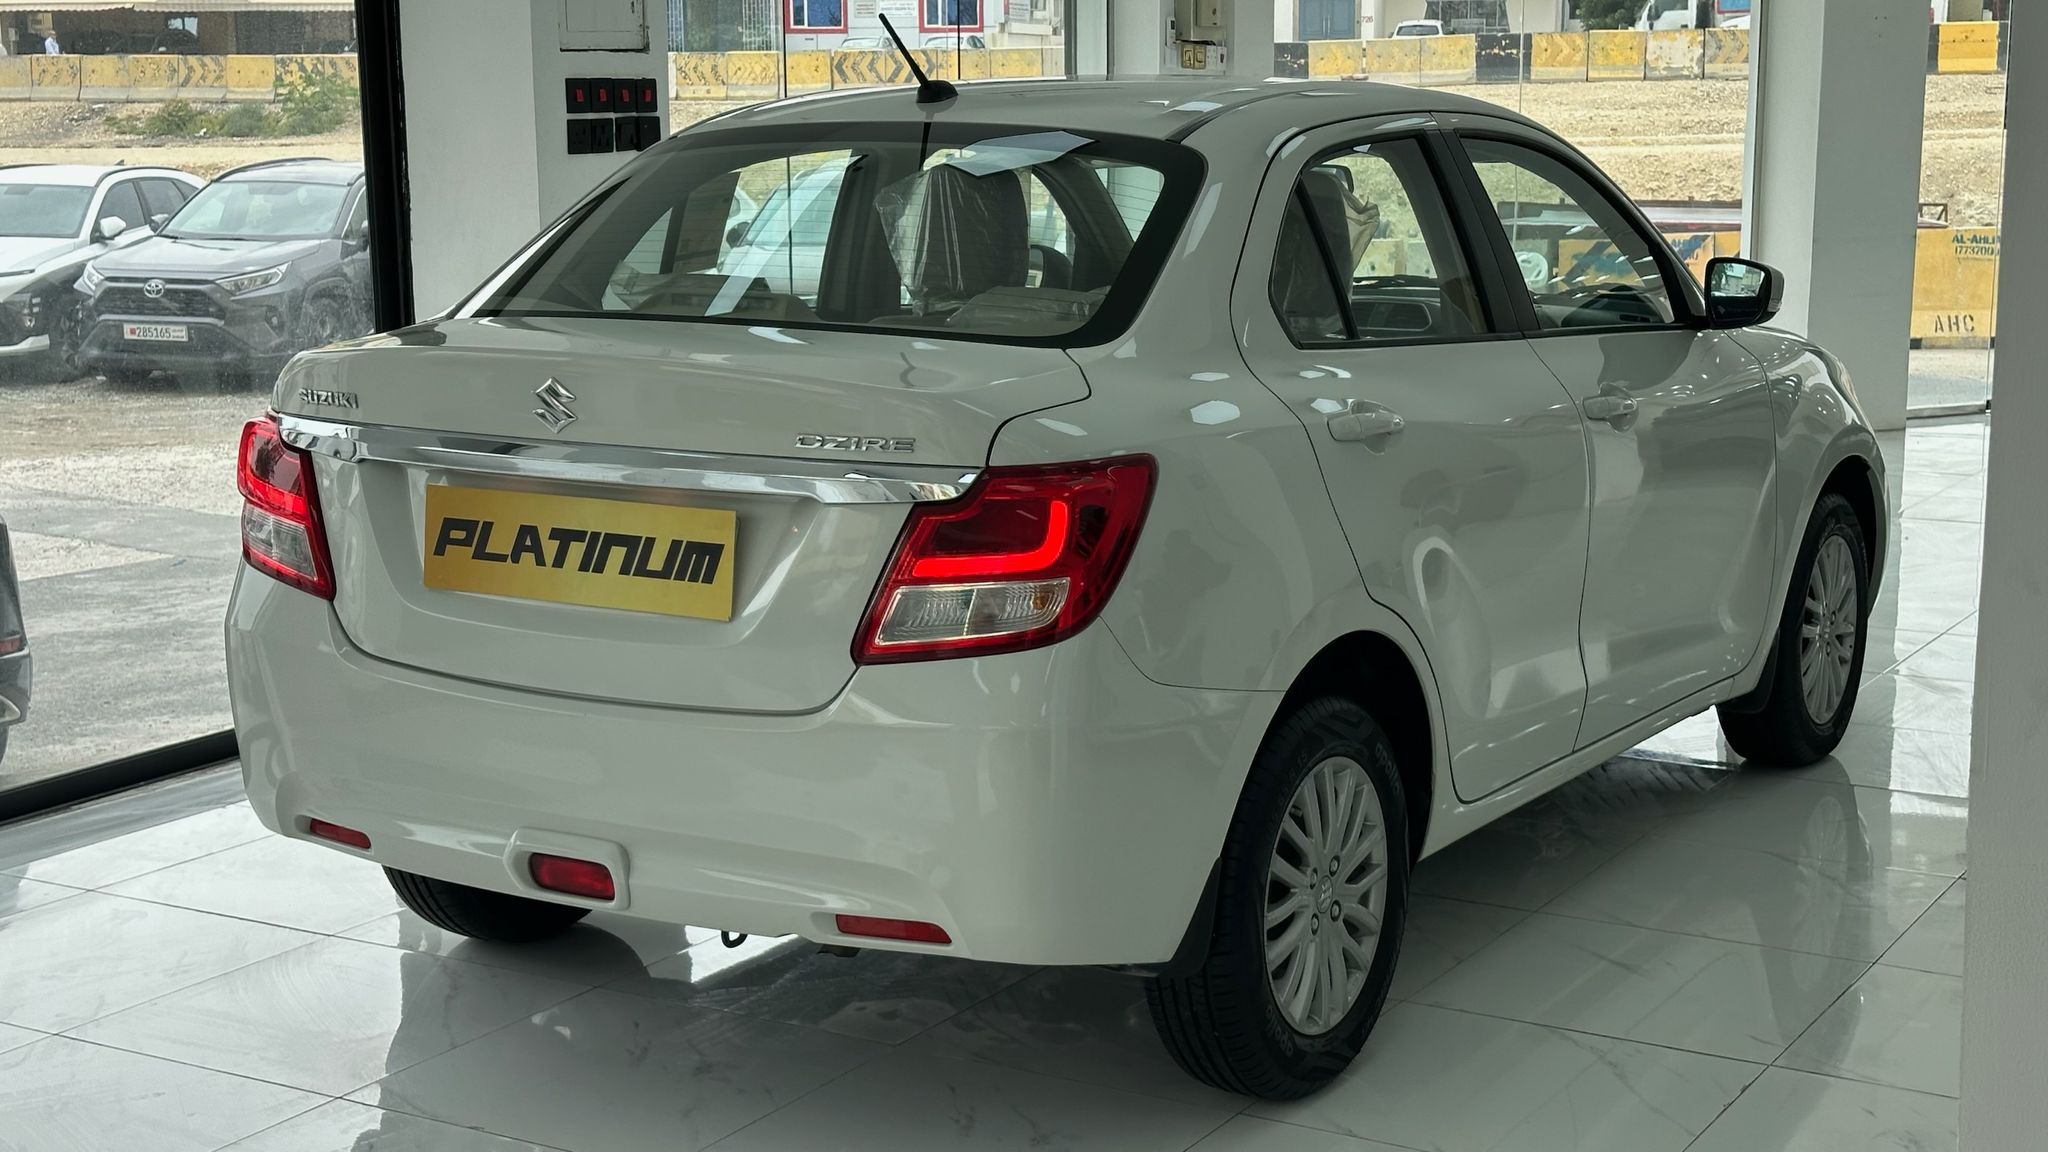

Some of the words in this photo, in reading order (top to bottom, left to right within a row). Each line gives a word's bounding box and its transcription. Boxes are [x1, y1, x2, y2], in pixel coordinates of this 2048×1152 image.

[136, 327, 171, 338] 285165
[1935, 314, 1974, 333] AHC
[299, 388, 359, 409] SUZUKI
[795, 434, 916, 453] DZIRE
[433, 517, 726, 584] PLATINUM
